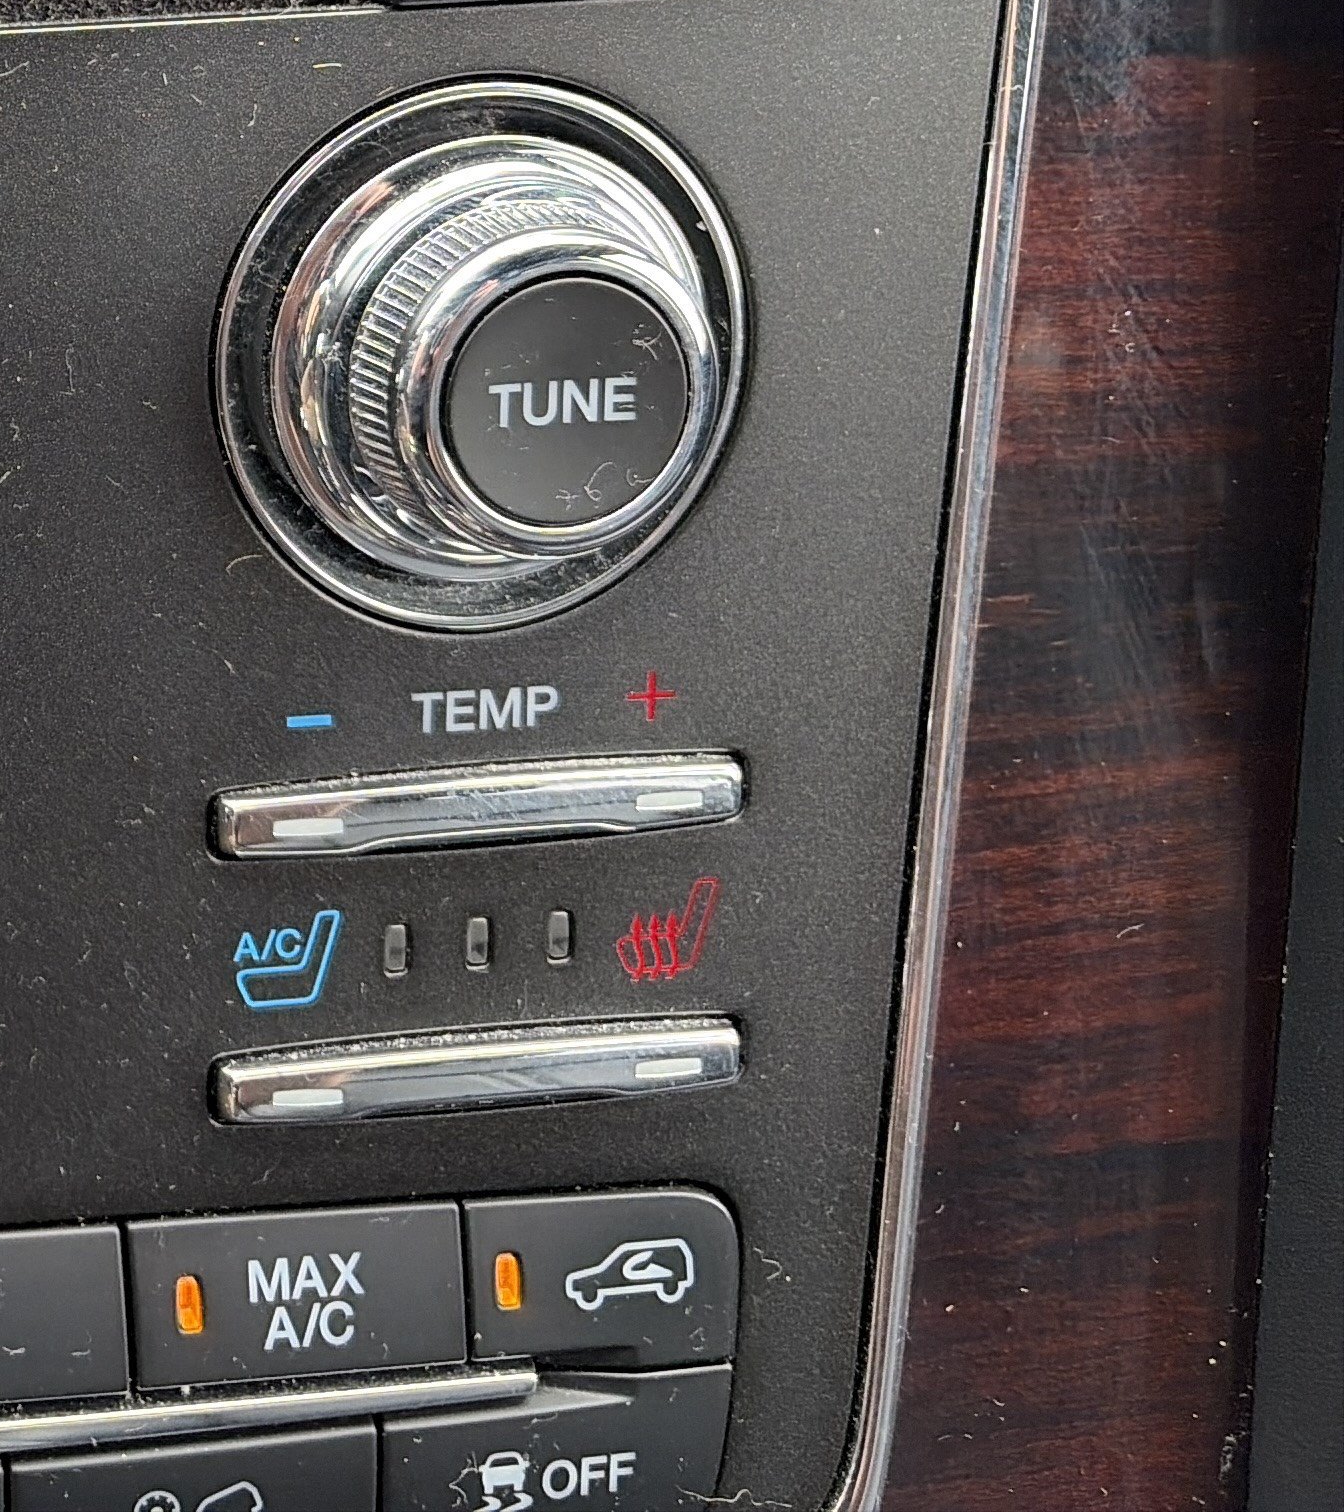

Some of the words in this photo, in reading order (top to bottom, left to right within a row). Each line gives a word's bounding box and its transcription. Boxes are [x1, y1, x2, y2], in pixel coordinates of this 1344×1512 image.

[487, 375, 638, 429] TUNE
[410, 684, 560, 735] TEMP
[232, 927, 304, 964] A/C
[246, 1250, 366, 1304] MAX
[263, 1298, 356, 1352] A/C
[541, 1451, 637, 1501] OFF
